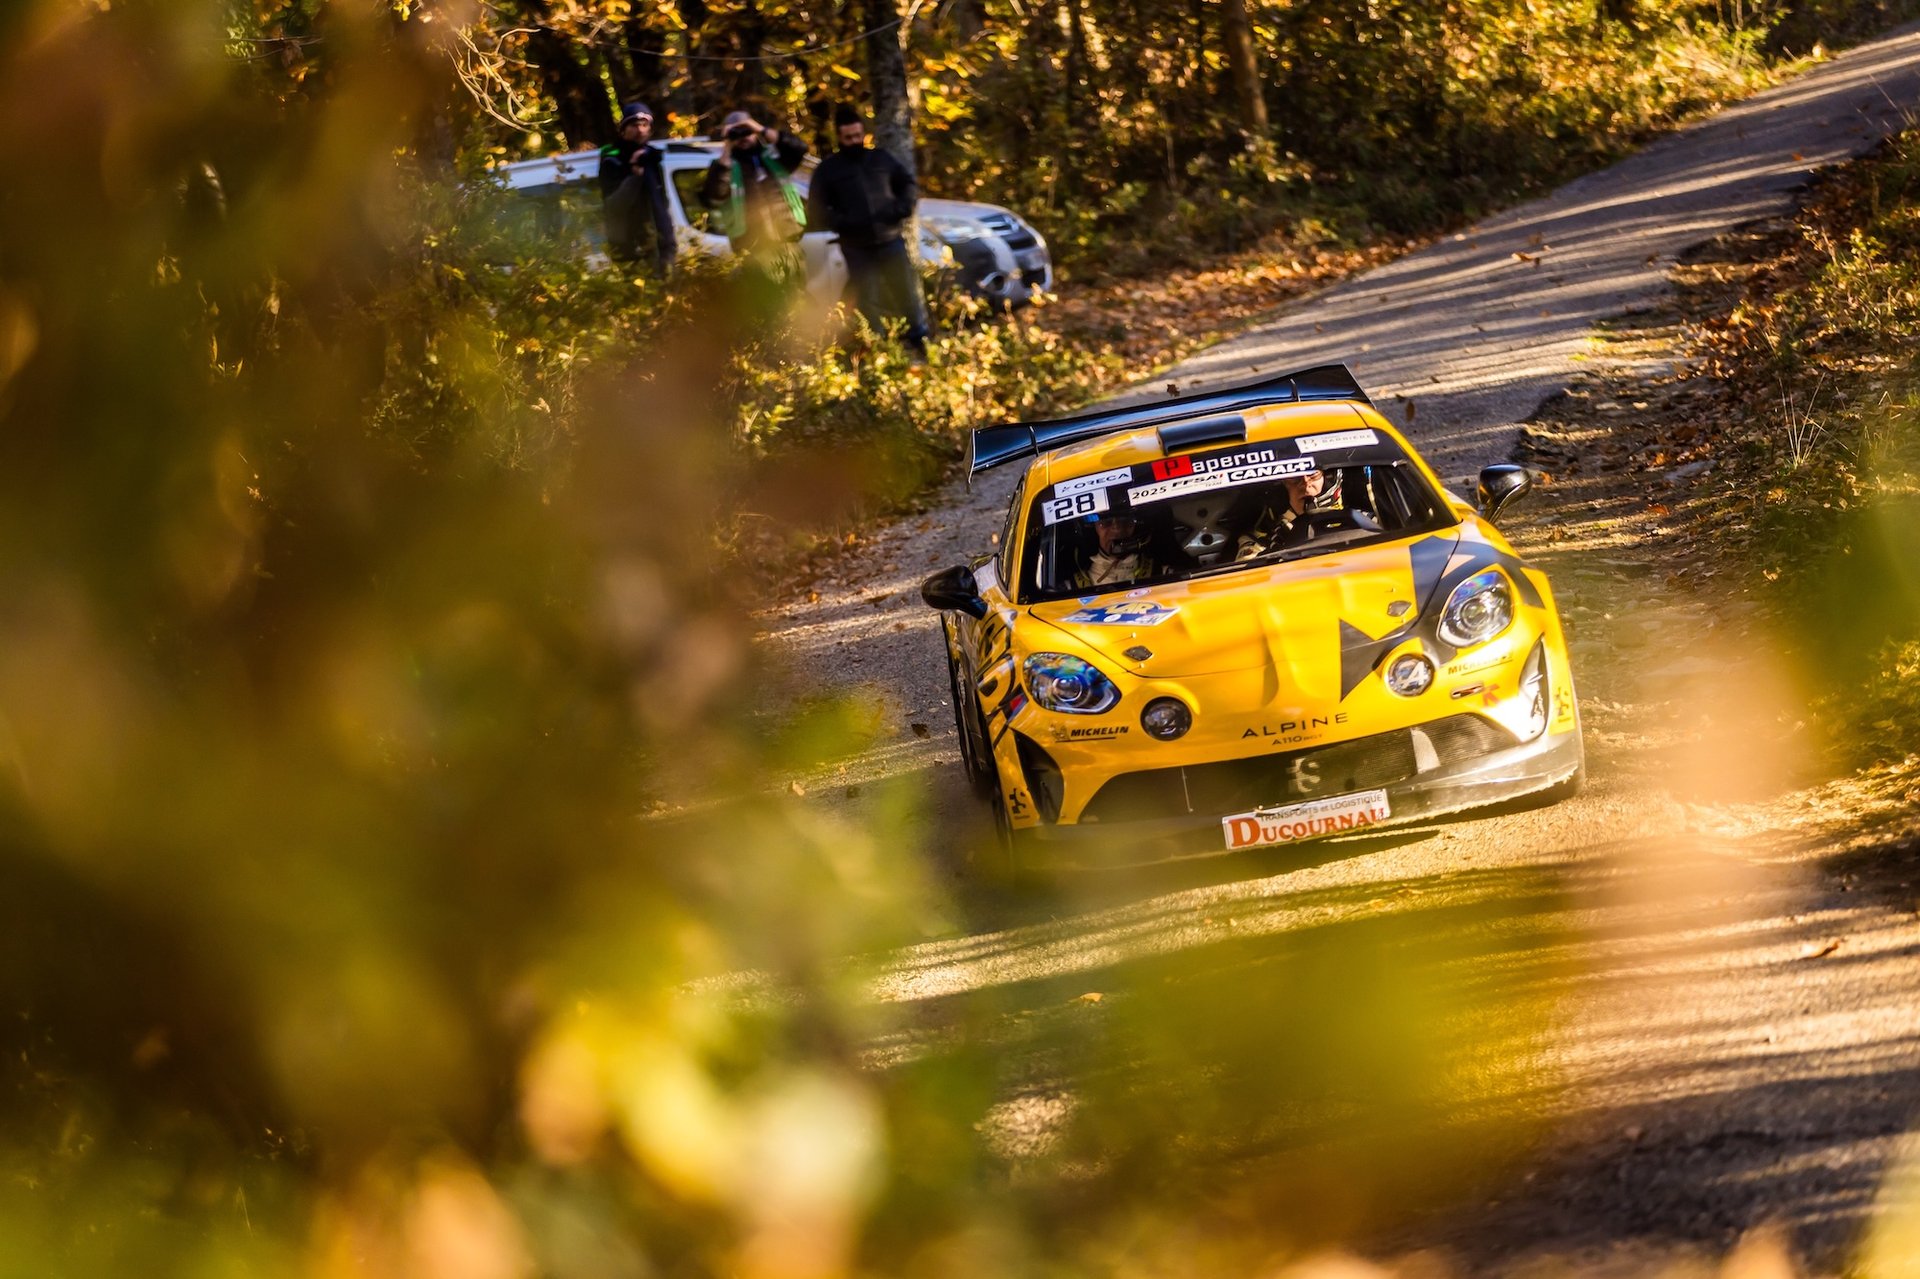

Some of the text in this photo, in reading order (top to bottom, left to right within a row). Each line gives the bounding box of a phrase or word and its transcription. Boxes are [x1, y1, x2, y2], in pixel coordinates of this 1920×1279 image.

[1163, 449, 1275, 477] Paperon
[1074, 473, 1130, 489] ORECA
[1131, 485, 1168, 500] 2025
[1172, 474, 1218, 488] FFSA
[1230, 460, 1311, 481] CANAL+
[1053, 492, 1096, 520] 28
[1070, 726, 1129, 737] MICHELIN
[1241, 712, 1349, 739] ALPINE
[1260, 795, 1383, 822] TRANSPORTS et LOGISTIQUE
[1228, 806, 1386, 848] DUCOURNAU
